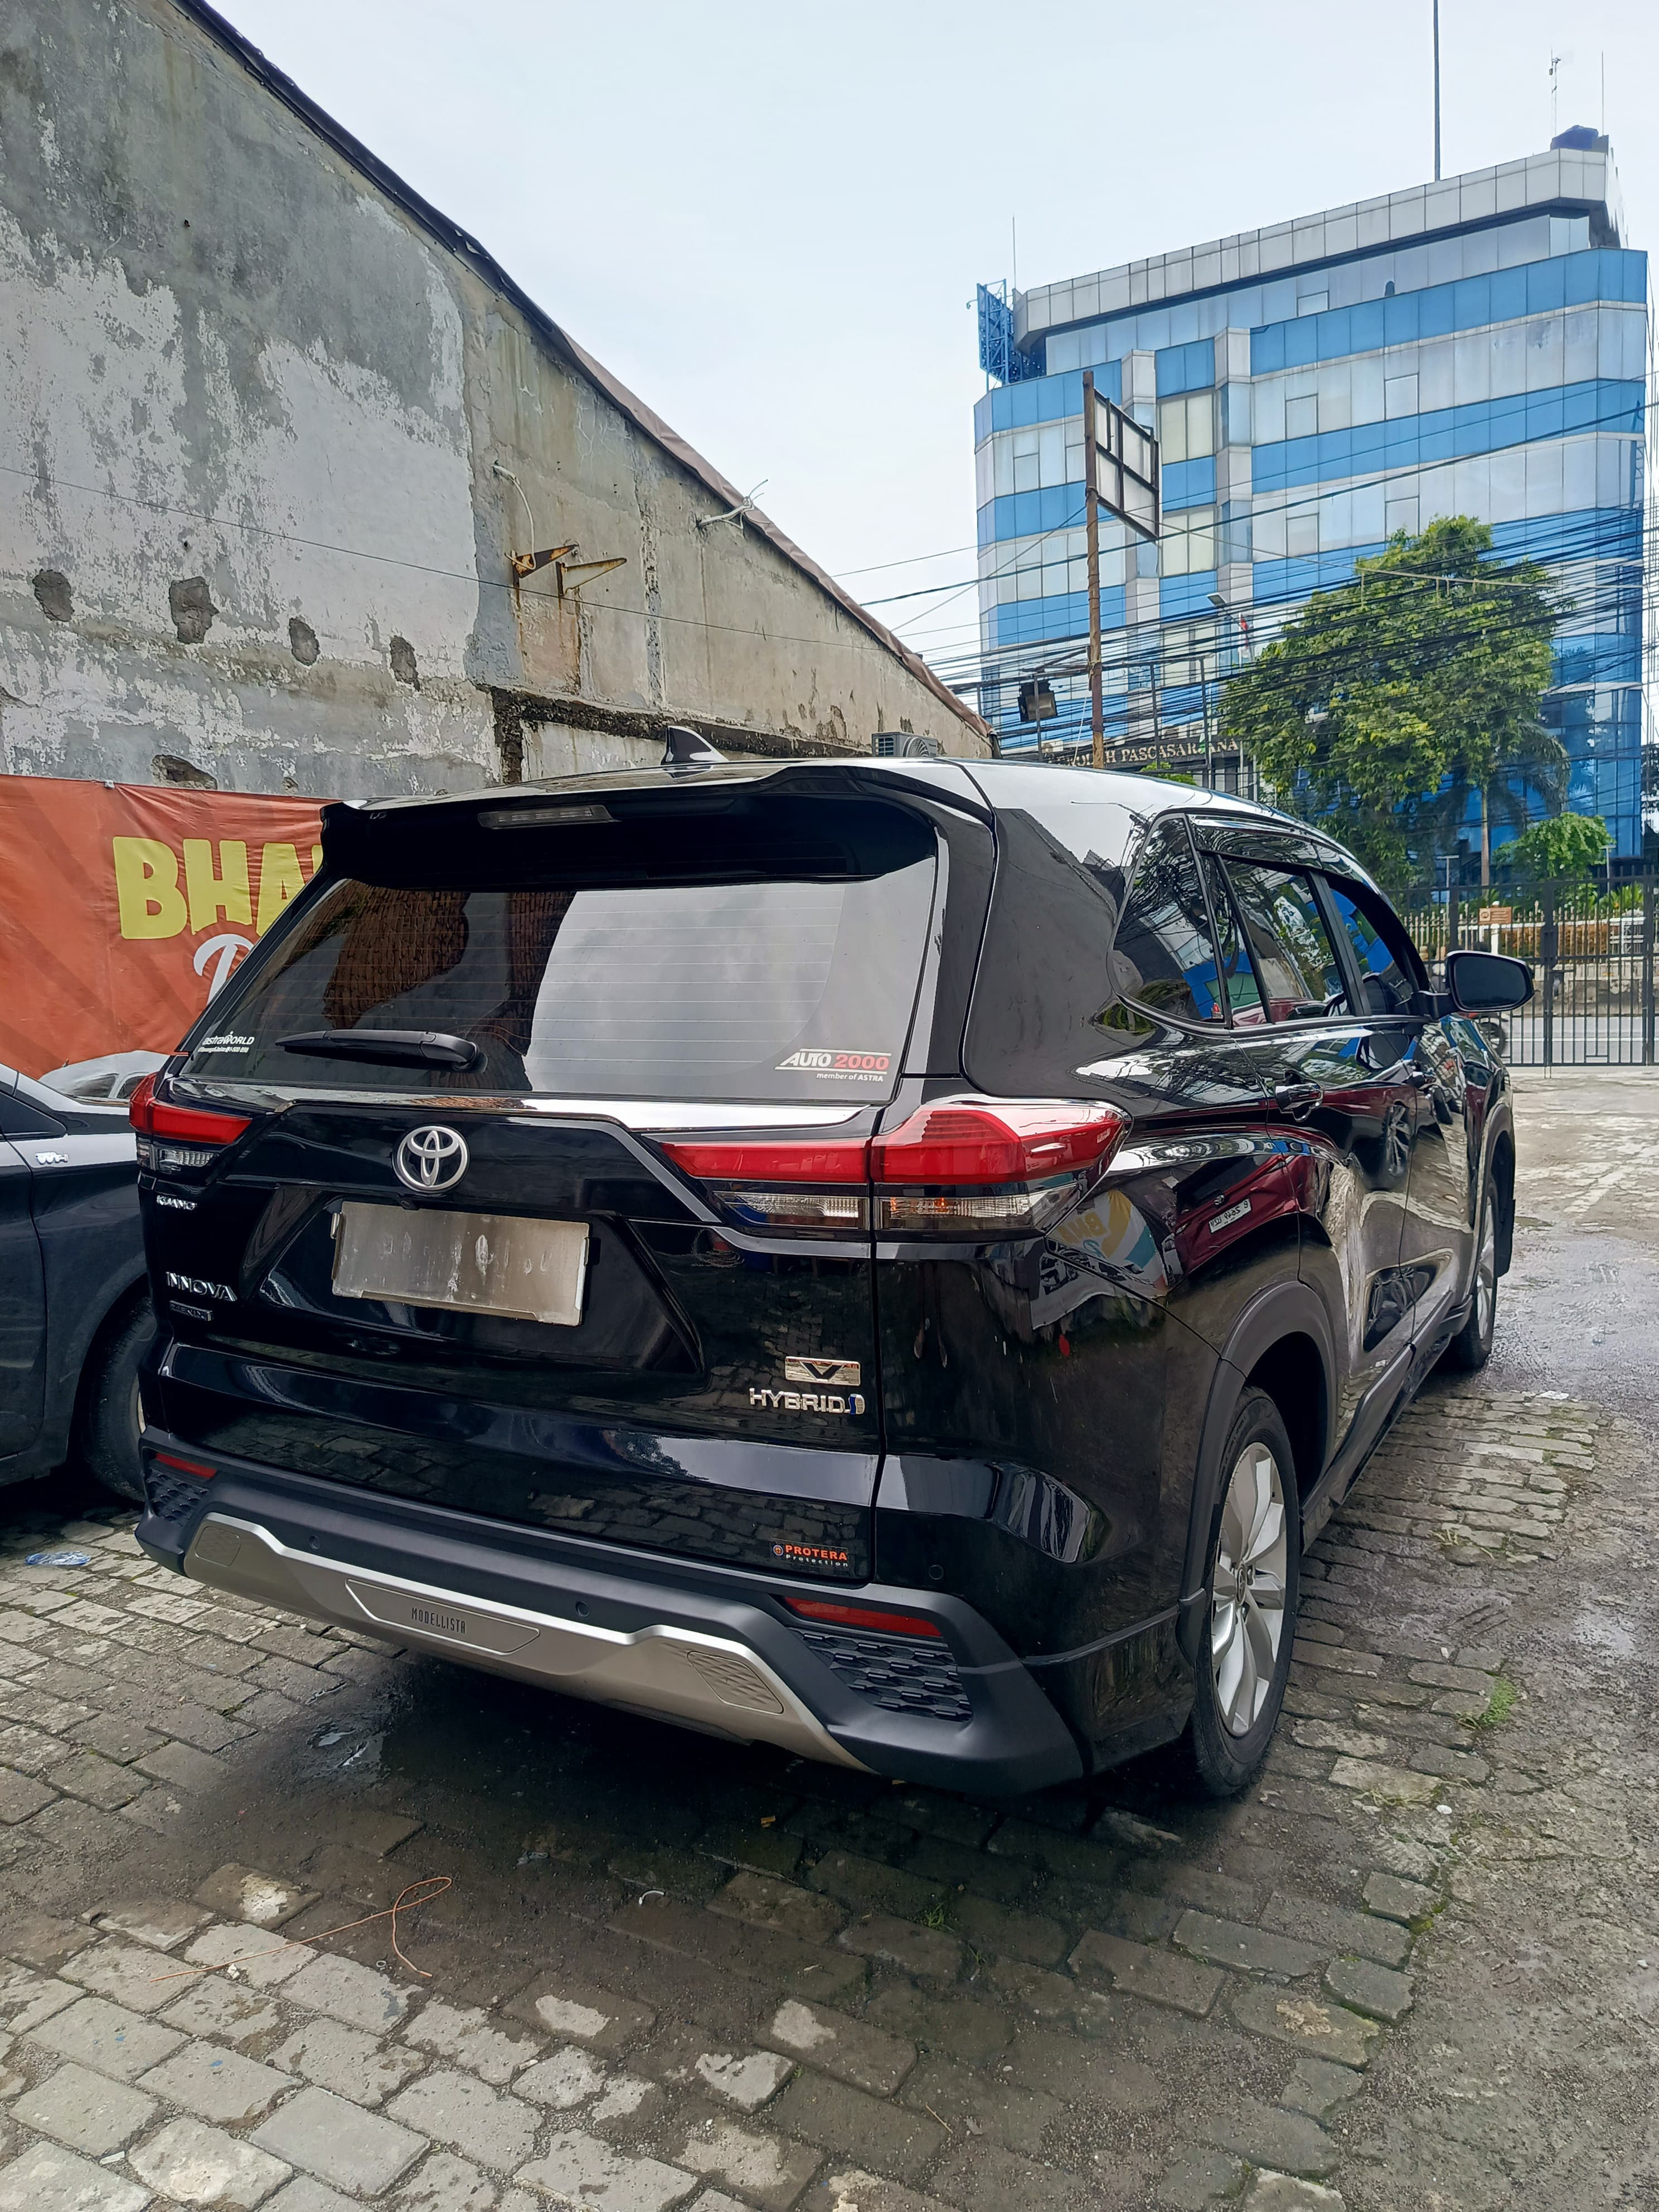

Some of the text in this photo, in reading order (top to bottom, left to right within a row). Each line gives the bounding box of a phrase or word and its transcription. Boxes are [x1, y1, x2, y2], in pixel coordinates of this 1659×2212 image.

[112, 836, 323, 939] BHA
[780, 1052, 889, 1071] AUTO 2000
[166, 1272, 238, 1302] INNOVA
[749, 1388, 846, 1413] HYBRID
[784, 1544, 848, 1561] PROTERA
[411, 1607, 465, 1634] MODELLISTA
